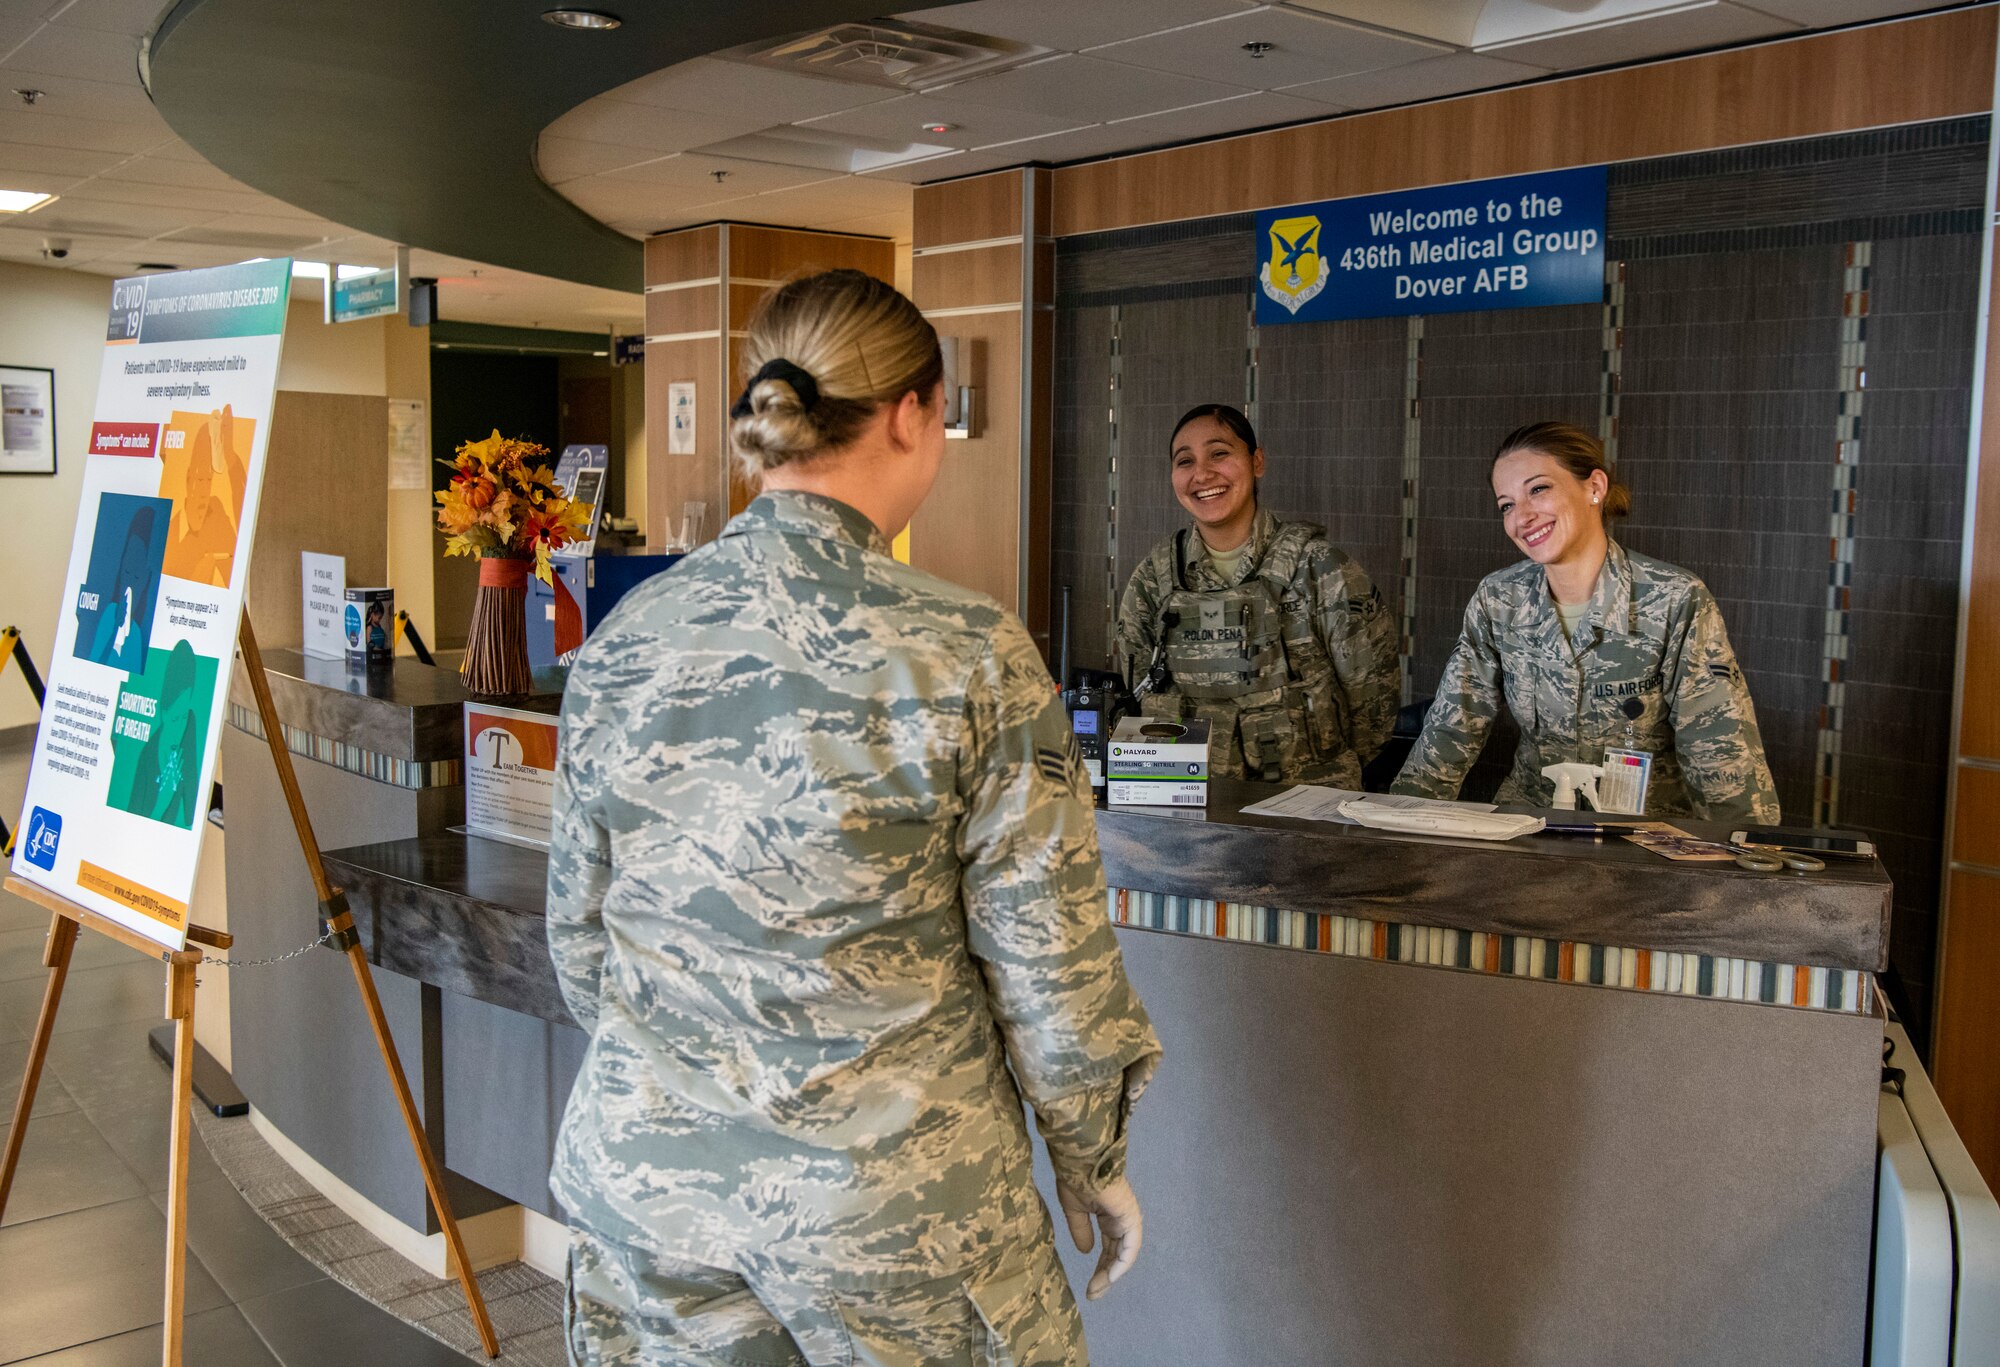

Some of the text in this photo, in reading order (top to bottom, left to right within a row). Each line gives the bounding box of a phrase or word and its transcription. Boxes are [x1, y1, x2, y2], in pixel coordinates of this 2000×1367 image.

[1369, 193, 1562, 236] Welcome to the
[1340, 228, 1598, 272] 436th Medical Group
[1395, 265, 1528, 299] Dover AFB
[113, 284, 143, 310] COVID
[145, 286, 279, 316] SYMPTOMS OF CORONAVIRUS DISEASE 2019
[126, 310, 140, 336] 19
[124, 355, 247, 375] Patients with COVID-19 have experienced mild to
[146, 381, 210, 400] severe respiratory illness.
[122, 437, 131, 448] can
[131, 433, 150, 448] include
[165, 431, 185, 448] FEVER
[79, 592, 100, 611] COUGH
[186, 601, 195, 612] may
[195, 602, 209, 614] appear
[208, 603, 219, 614] 2-14
[310, 600, 321, 611] PLEASE
[329, 604, 335, 613] ON
[169, 613, 179, 626] days
[179, 614, 189, 626] after
[1184, 628, 1243, 641] ROLON PENA
[1595, 684, 1615, 697] U.S.
[1618, 681, 1637, 695] AIR
[120, 692, 157, 717] SHORTNESS
[115, 715, 151, 742] OF BREATH
[514, 764, 538, 776] TOGETHER
